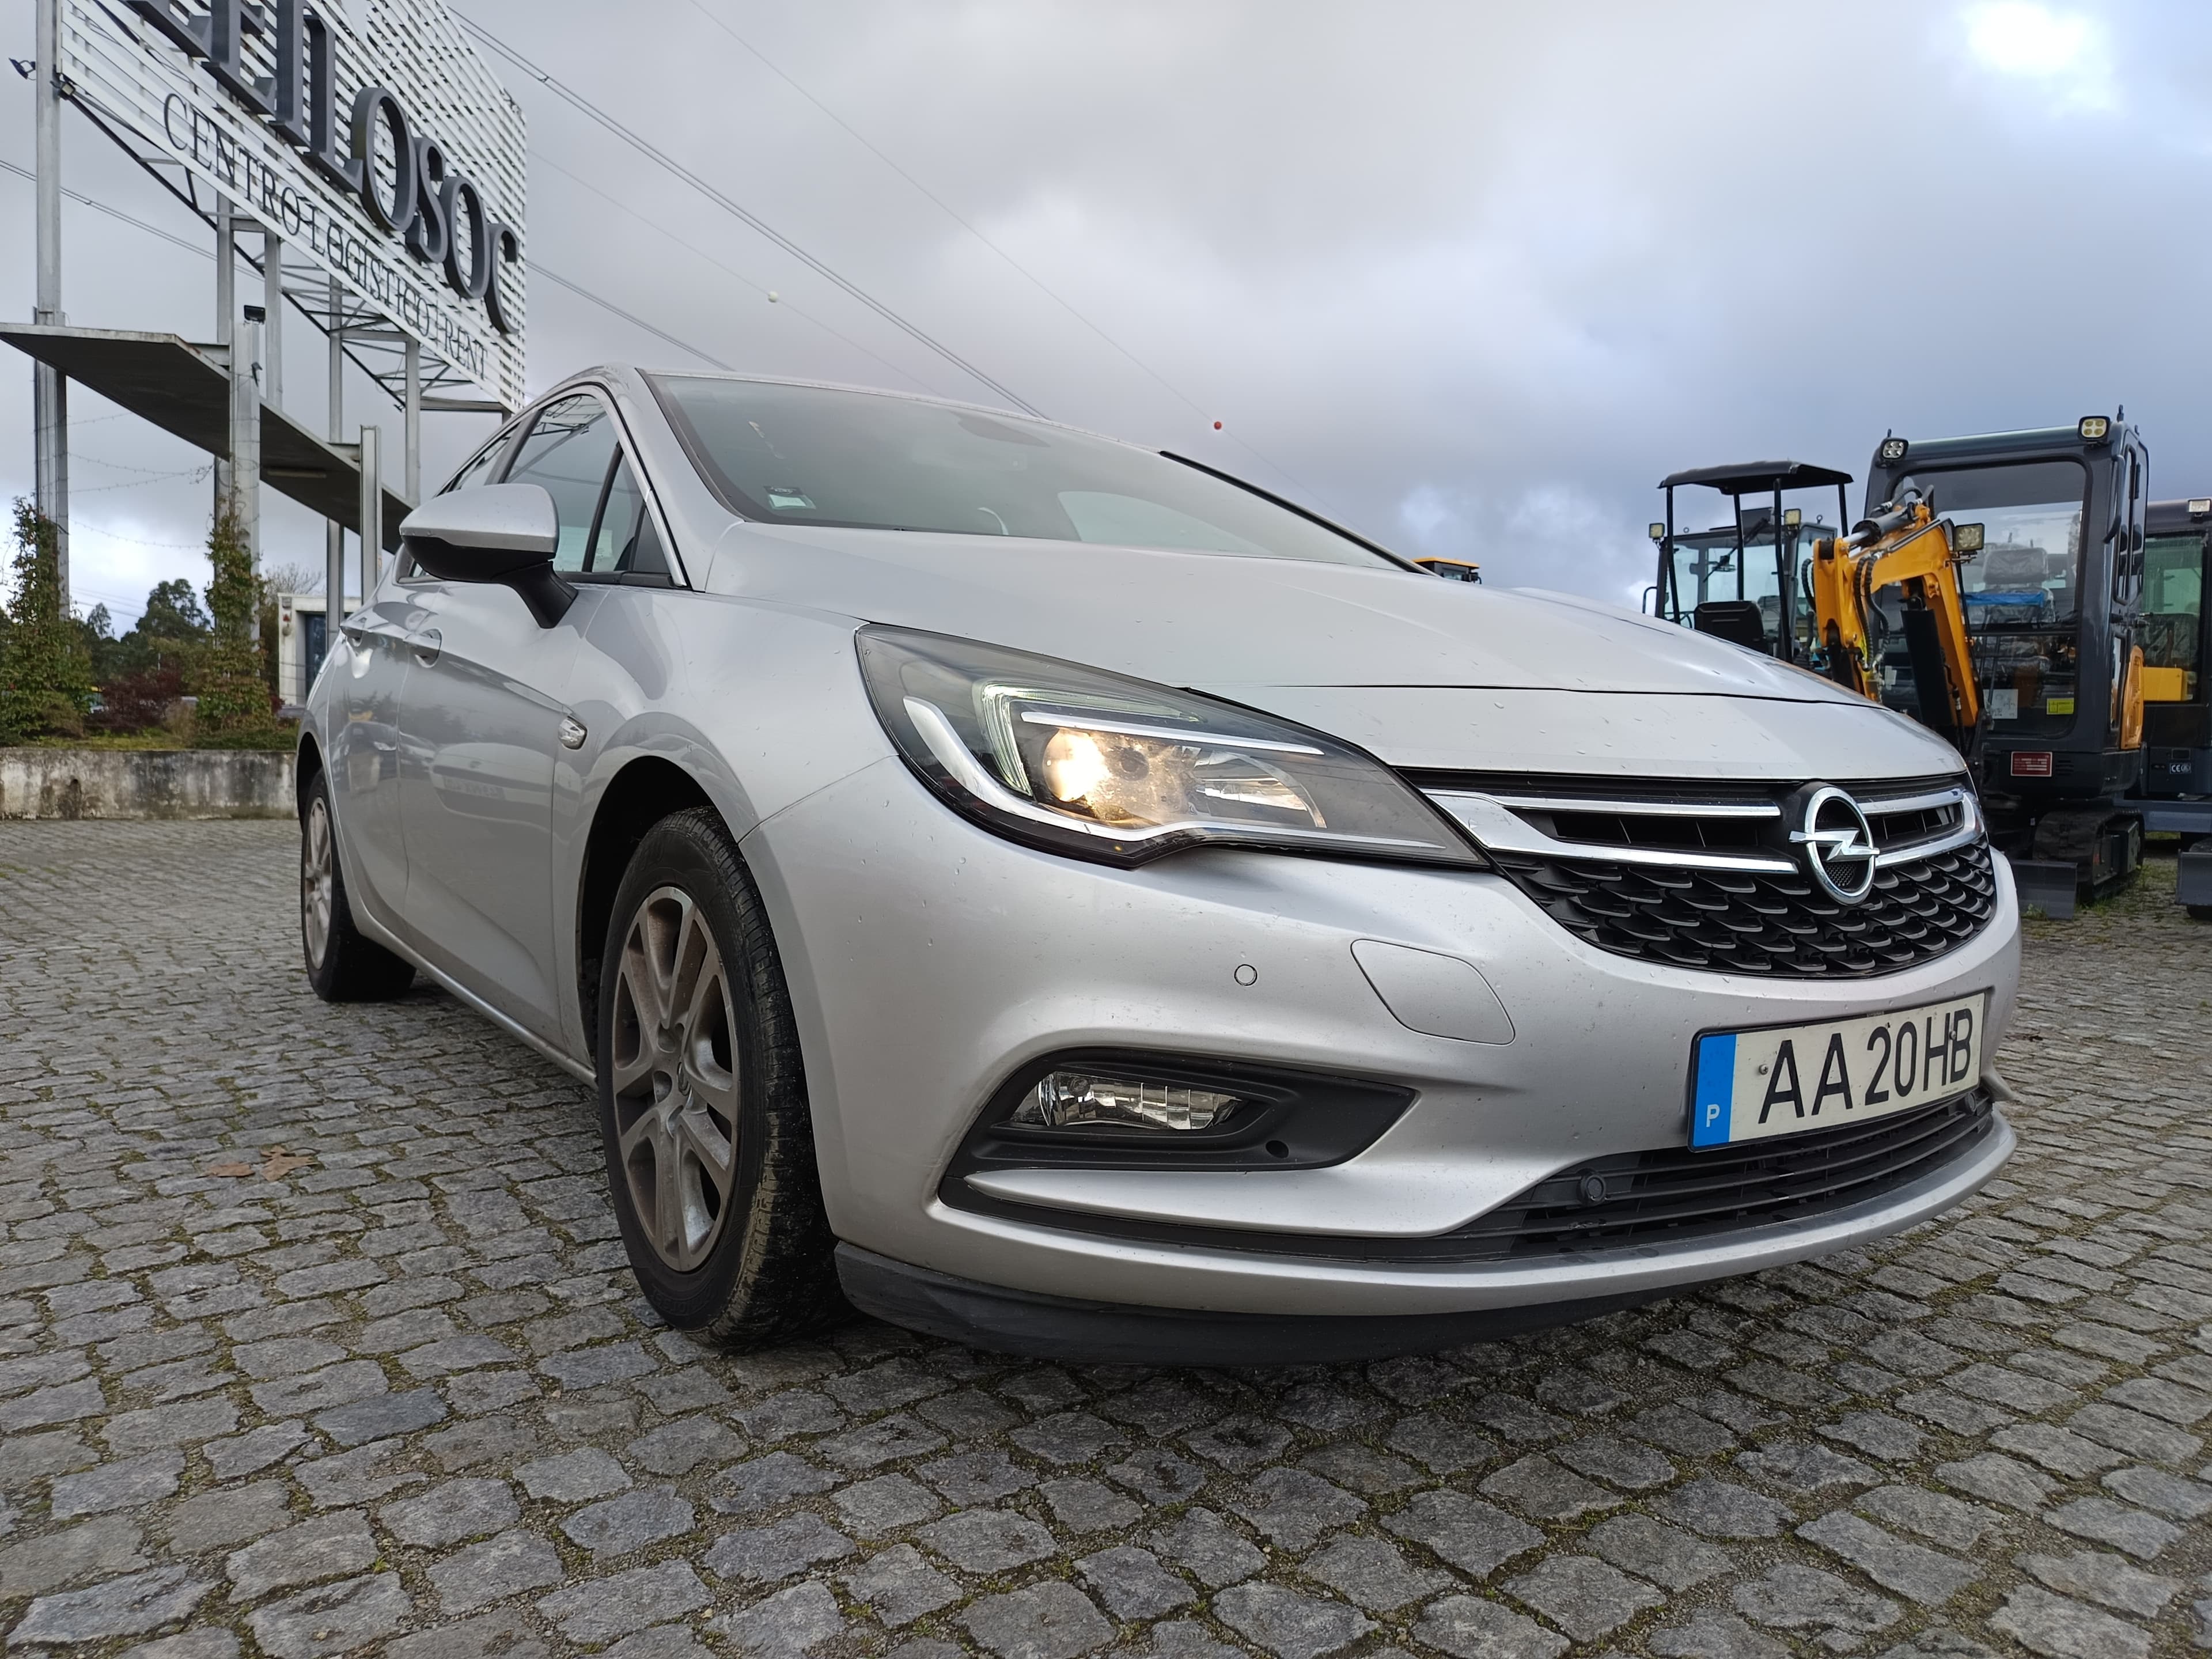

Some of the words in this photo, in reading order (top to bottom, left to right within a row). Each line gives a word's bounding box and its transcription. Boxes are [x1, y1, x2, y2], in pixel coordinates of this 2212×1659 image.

[164, 93, 300, 236] CENTRO
[304, 201, 430, 336] LOGÍSTICO
[444, 316, 488, 381] RENT
[1706, 1104, 1721, 1127] P
[1758, 1033, 1853, 1124] AA
[1865, 1021, 1918, 1105] 20
[1923, 1008, 1973, 1092] HB
